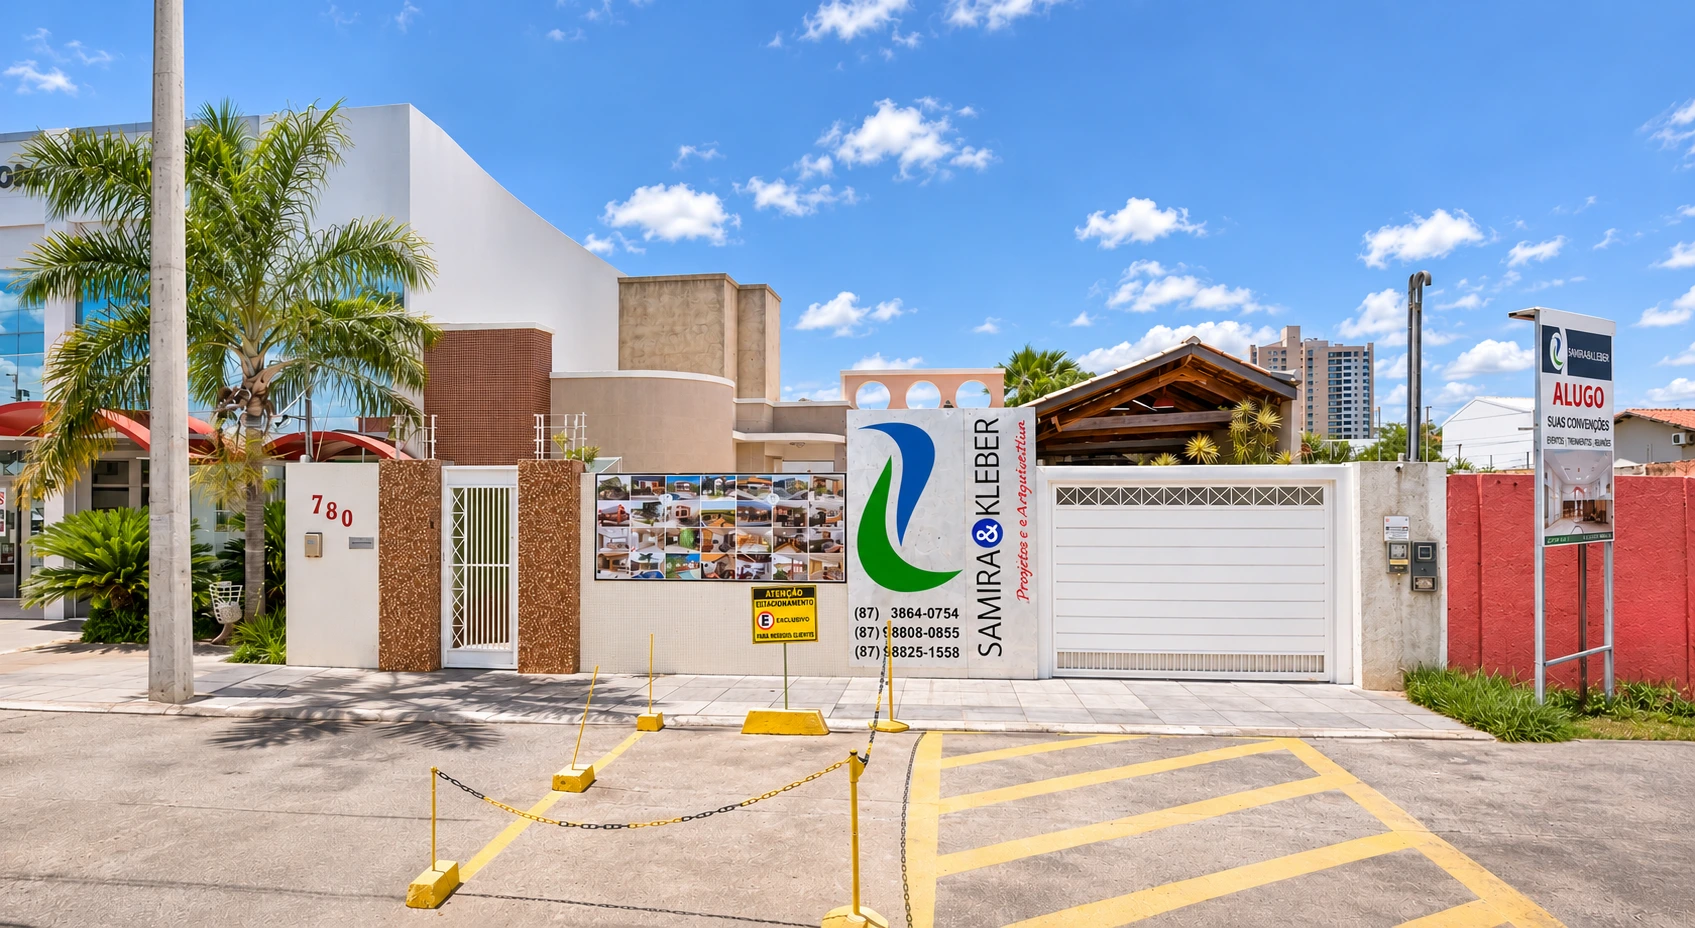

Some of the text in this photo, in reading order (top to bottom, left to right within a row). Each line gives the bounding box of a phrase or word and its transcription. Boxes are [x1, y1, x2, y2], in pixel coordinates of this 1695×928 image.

[1553, 381, 1604, 409] ALUGO
[1547, 415, 1610, 433] SUAS CONVENÇÕES
[974, 418, 1001, 516] KLEBER
[312, 494, 353, 528] 780
[976, 549, 1002, 657] SAMIRA
[761, 614, 770, 627] E
[854, 606, 960, 621] (87) 3864-0754
[854, 626, 880, 640] (87)
[855, 645, 881, 660] (87)
